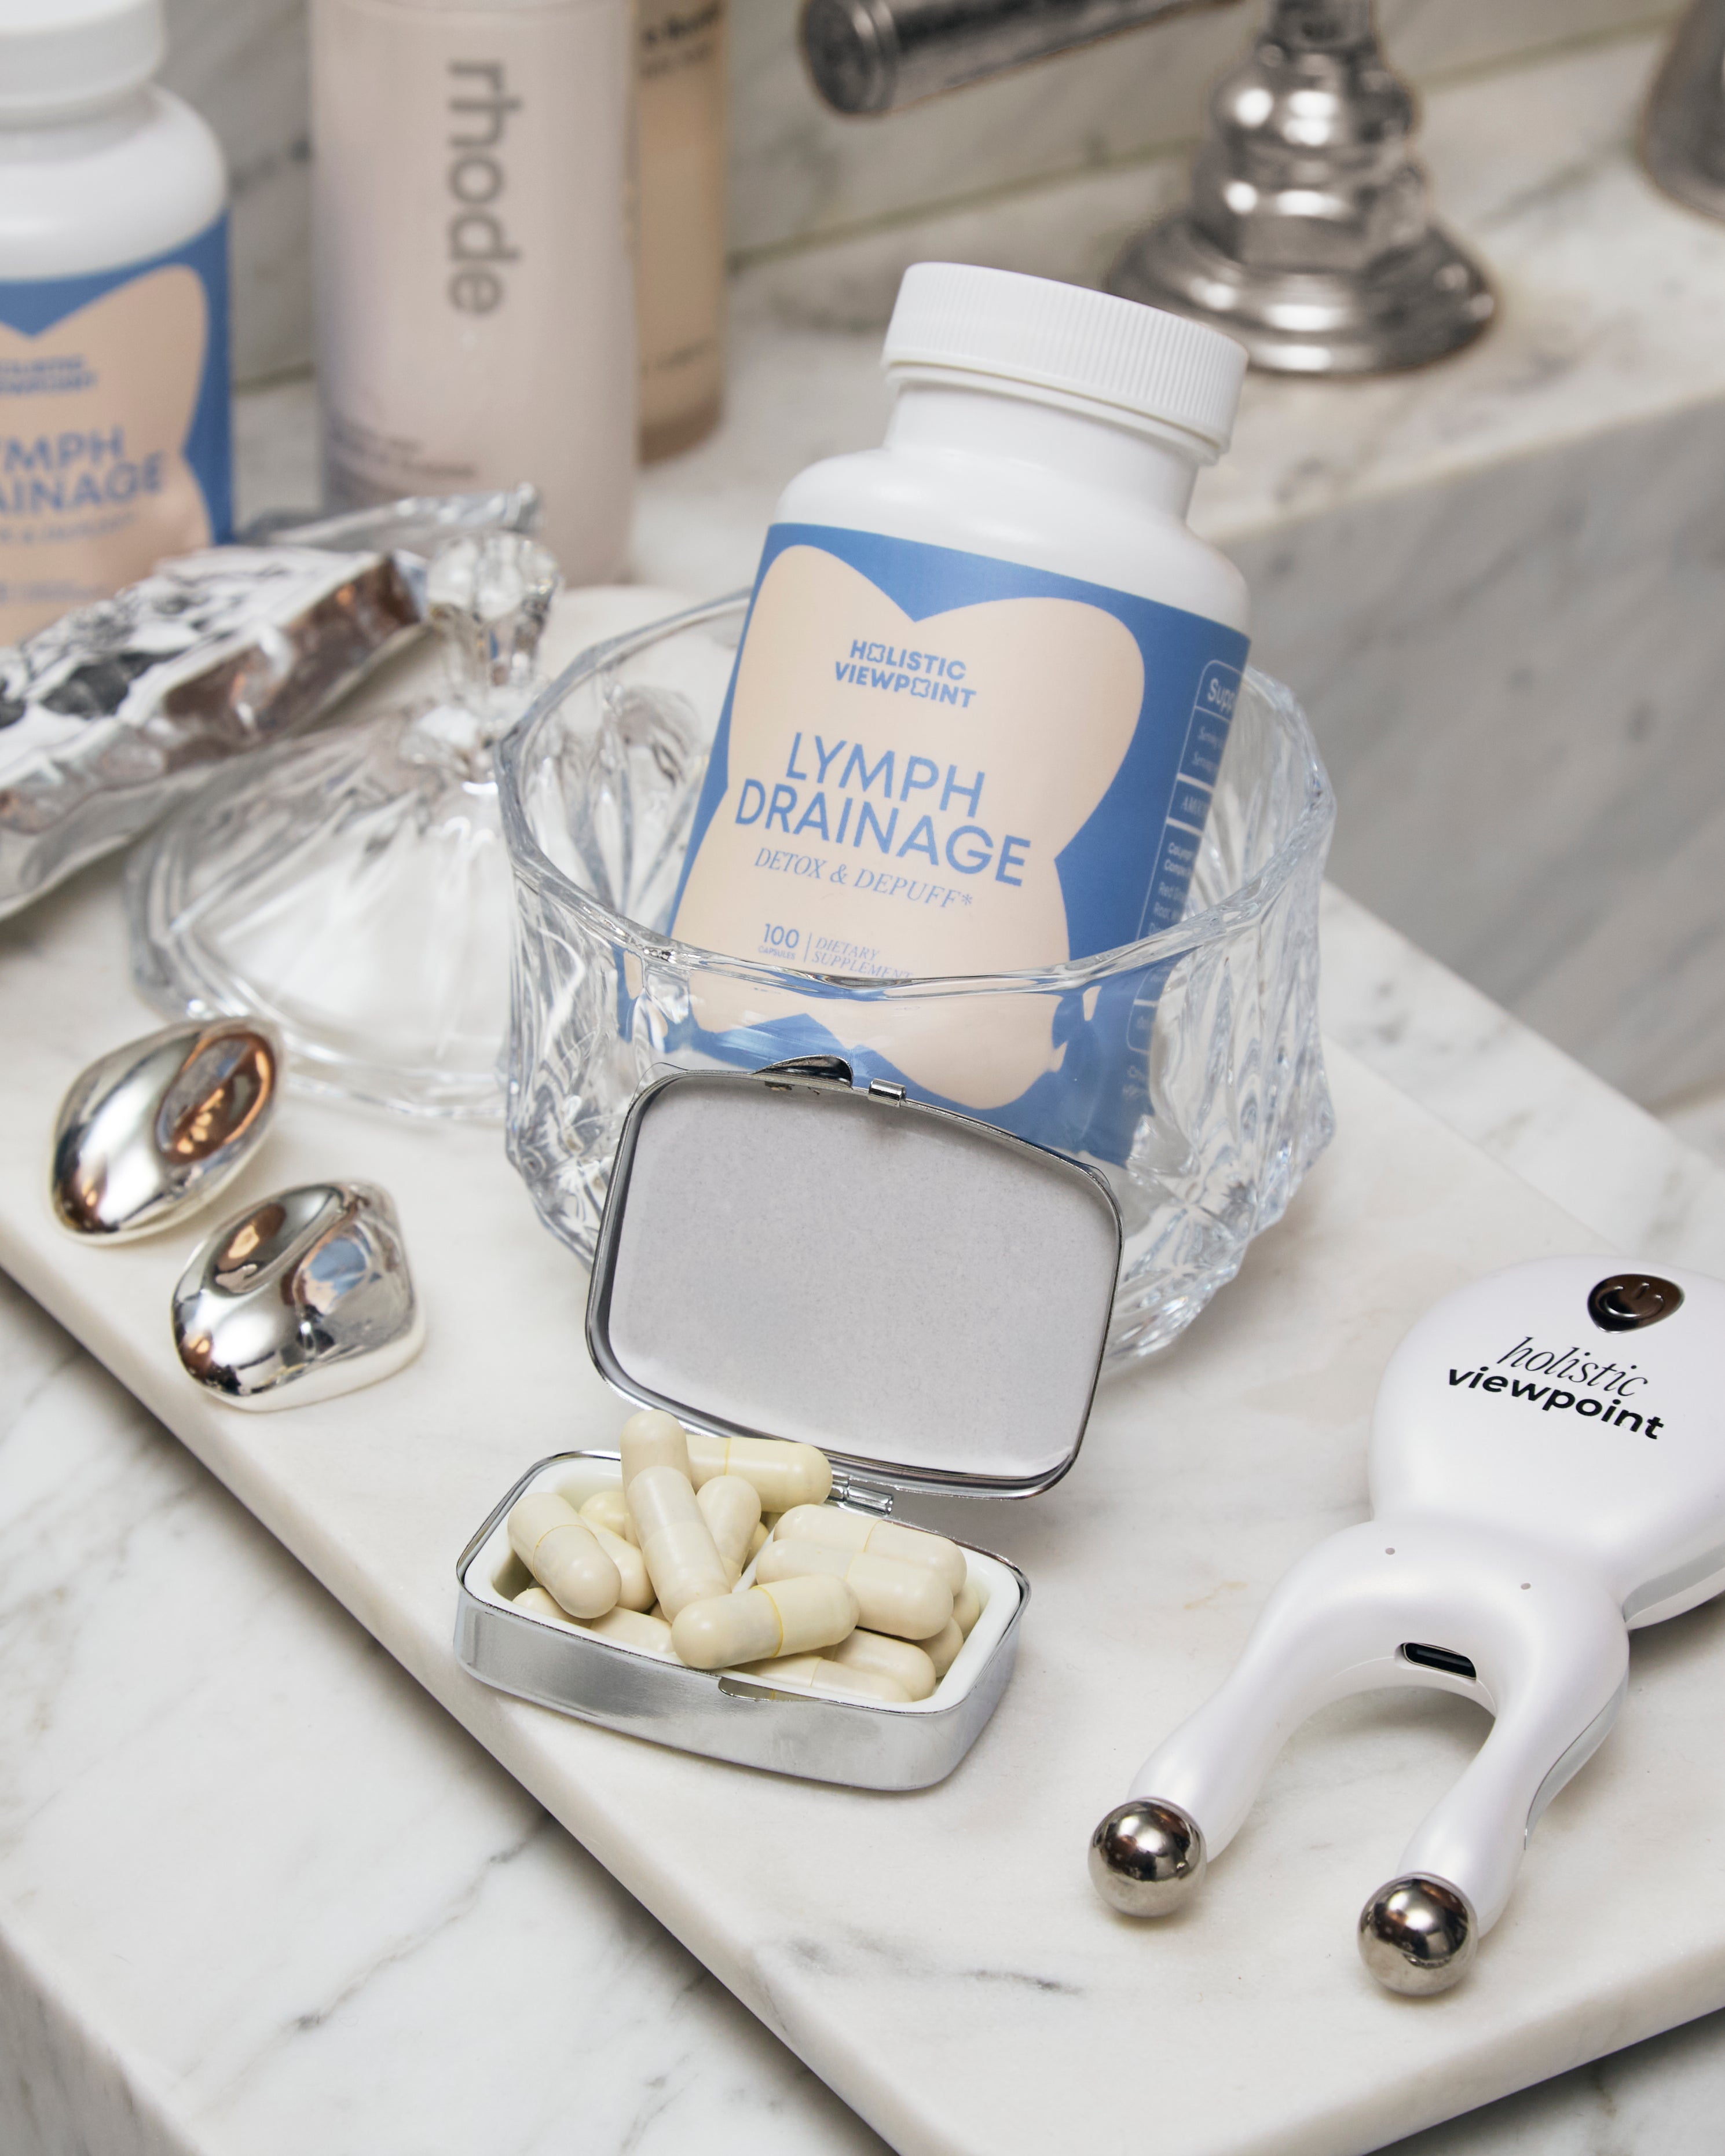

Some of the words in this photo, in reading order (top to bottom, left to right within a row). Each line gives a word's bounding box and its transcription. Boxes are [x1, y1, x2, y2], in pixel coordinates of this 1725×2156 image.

[449, 61, 522, 315] rhode
[849, 639, 966, 681] HOLISTIC
[835, 661, 977, 709] VIEWPOINT
[785, 732, 986, 818] LYMPH
[735, 778, 1031, 887] DRAINAGE
[755, 847, 822, 879] DETOX
[829, 863, 848, 885] &
[757, 945, 797, 961] CAPSULES
[763, 923, 801, 949] 100
[814, 936, 880, 962] DIETARY
[1497, 1336, 1648, 1396] holistic
[1448, 1366, 1664, 1440] viewpoint
